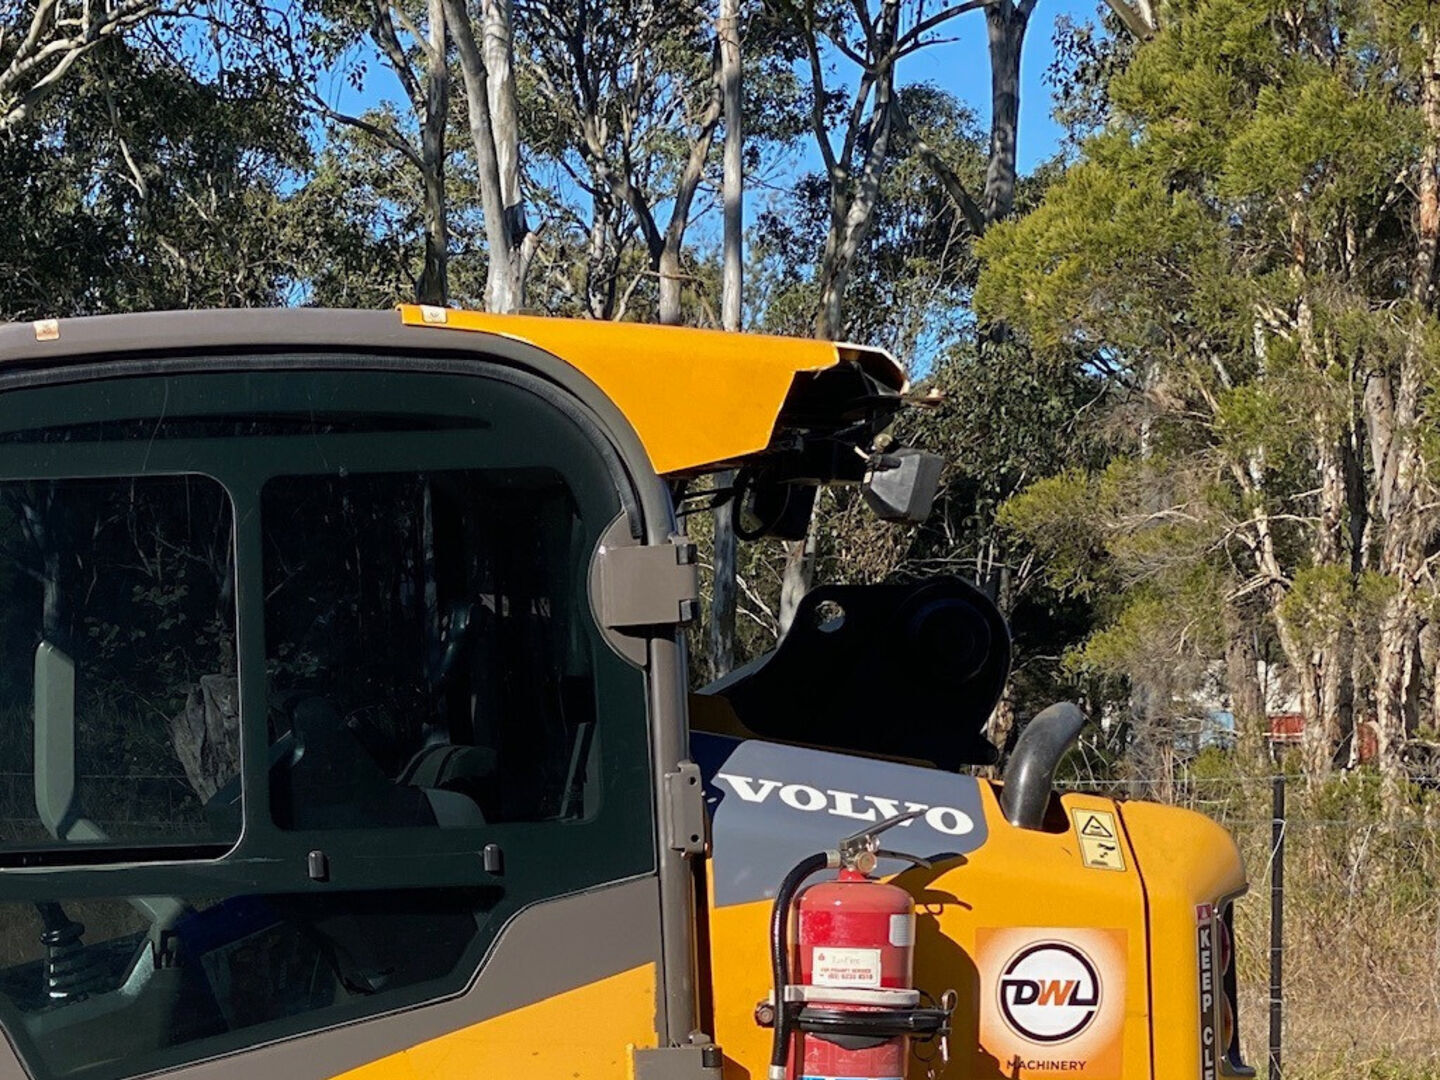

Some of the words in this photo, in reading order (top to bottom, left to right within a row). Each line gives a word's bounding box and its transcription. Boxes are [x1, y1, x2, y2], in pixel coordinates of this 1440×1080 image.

[718, 773, 974, 835] VOLVO
[1001, 979, 1099, 1006] DWL
[1200, 928, 1213, 1013] KEEP
[1006, 1059, 1087, 1071] MACHINERY
